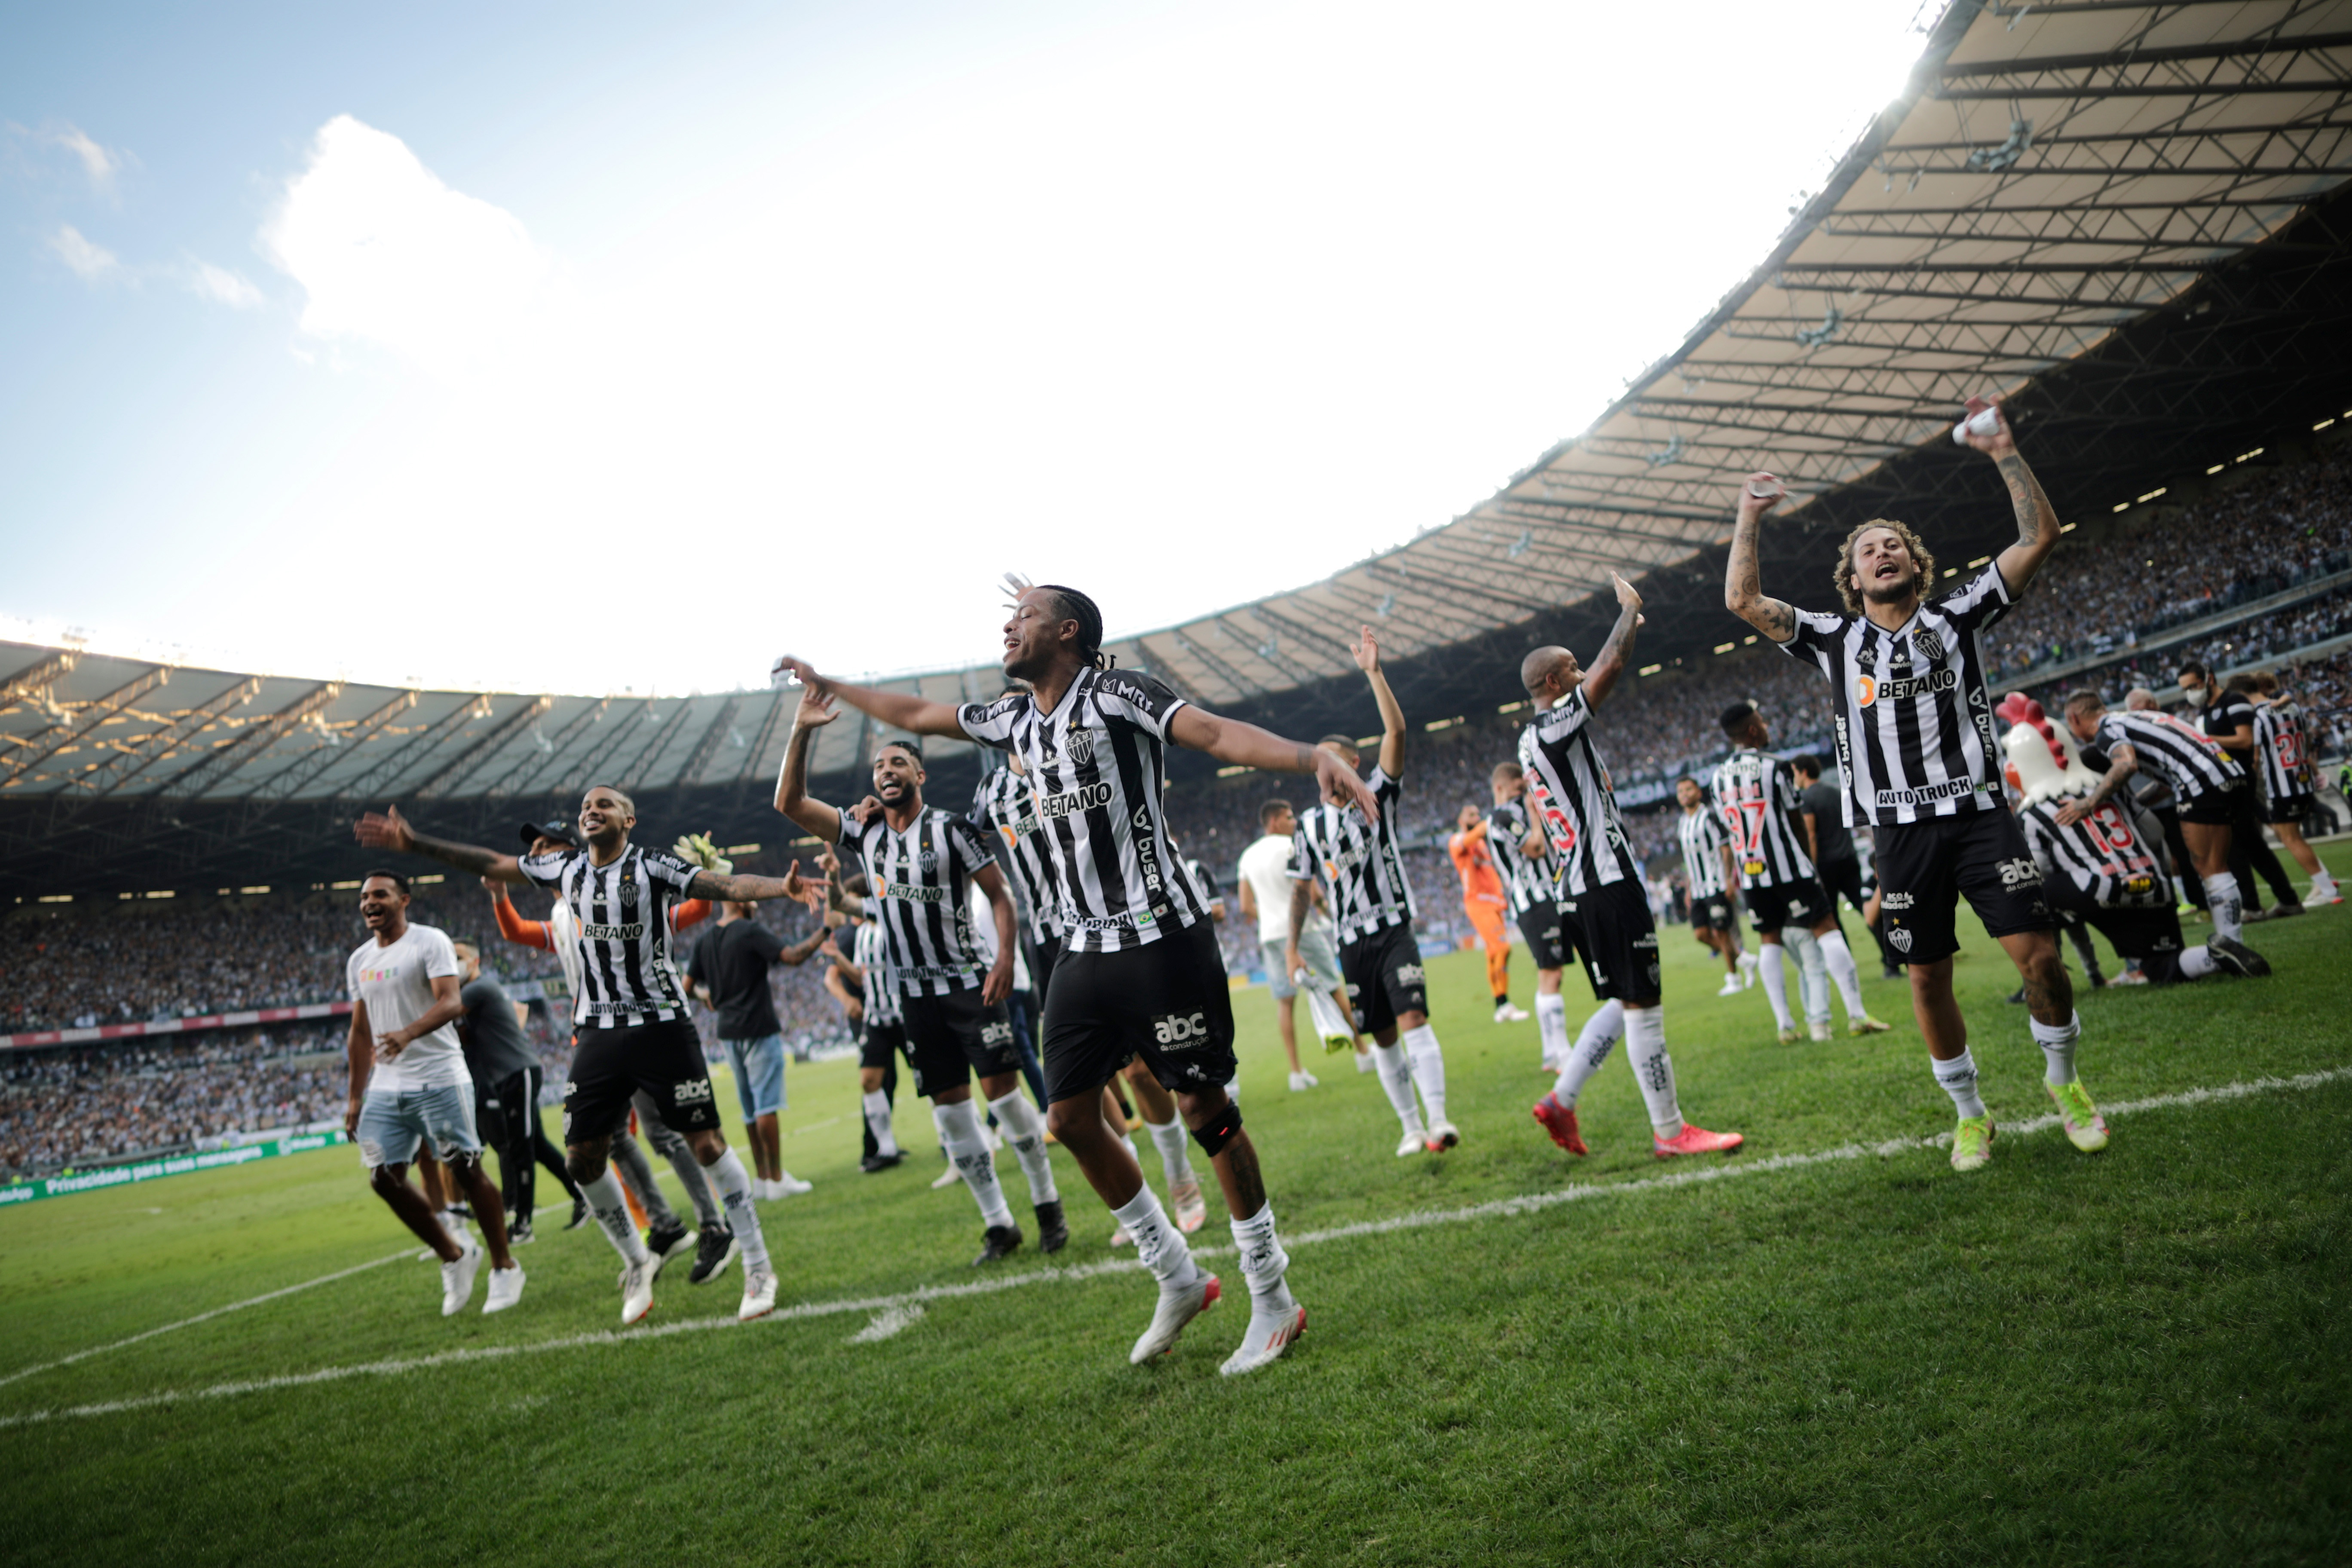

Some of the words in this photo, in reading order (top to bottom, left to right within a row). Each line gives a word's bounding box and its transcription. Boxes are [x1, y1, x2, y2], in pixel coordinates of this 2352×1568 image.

[1878, 669, 1956, 699] BETANO
[986, 698, 1015, 722] MRV
[1551, 702, 1574, 723] MRV
[1069, 733, 1089, 746] CAM
[1835, 714, 1850, 762] buser
[1975, 713, 1993, 762] buser
[2275, 732, 2309, 769] 20
[1041, 783, 1112, 817] BETANO
[1880, 791, 1913, 804] AUTO
[1918, 779, 1970, 801] TRUCK
[2084, 802, 2134, 854] 13
[660, 854, 687, 870] MRV
[1138, 836, 1161, 892] buser
[888, 883, 943, 901] BETANO
[585, 924, 643, 940] BETANO
[1155, 1012, 1207, 1044] abc
[674, 1078, 710, 1100] abc
[46, 1167, 131, 1195] Privacidade
[132, 1163, 163, 1182] para
